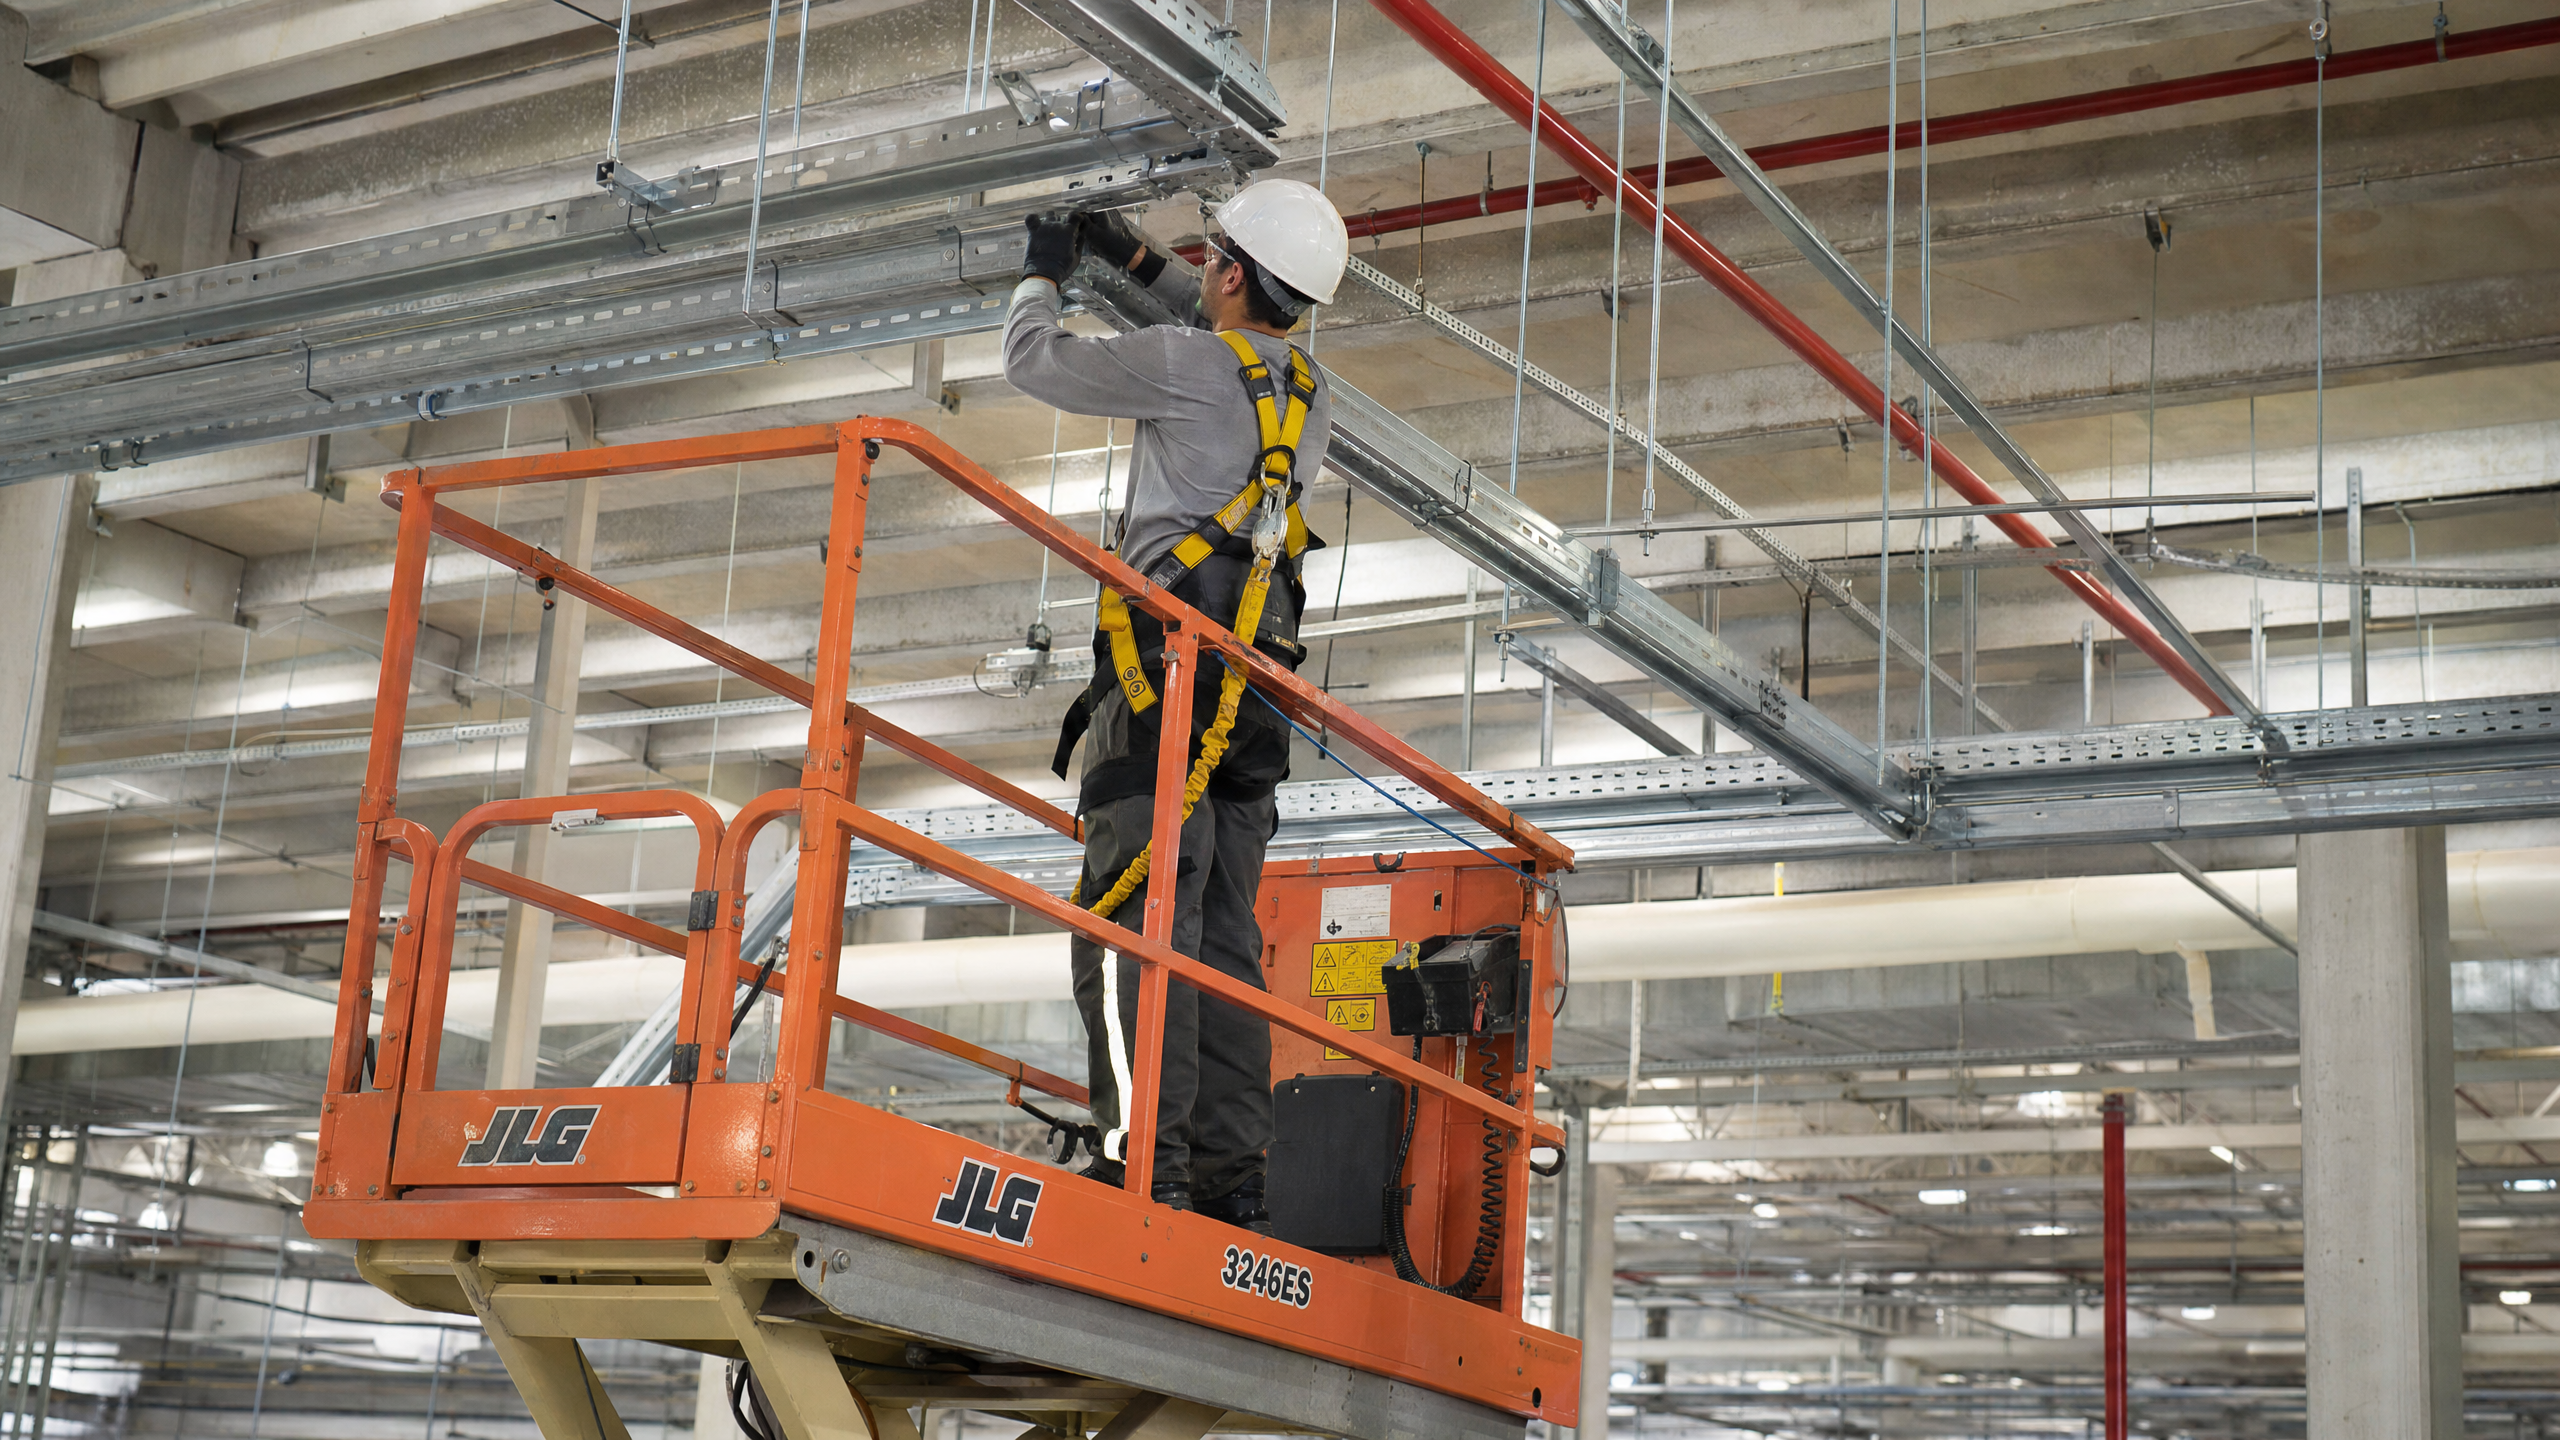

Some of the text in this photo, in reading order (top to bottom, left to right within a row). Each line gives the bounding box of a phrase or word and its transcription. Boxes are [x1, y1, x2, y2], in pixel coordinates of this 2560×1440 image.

[457, 1105, 602, 1167] JLG
[932, 1156, 1044, 1247] JLG
[1221, 1244, 1313, 1309] 3246ES
